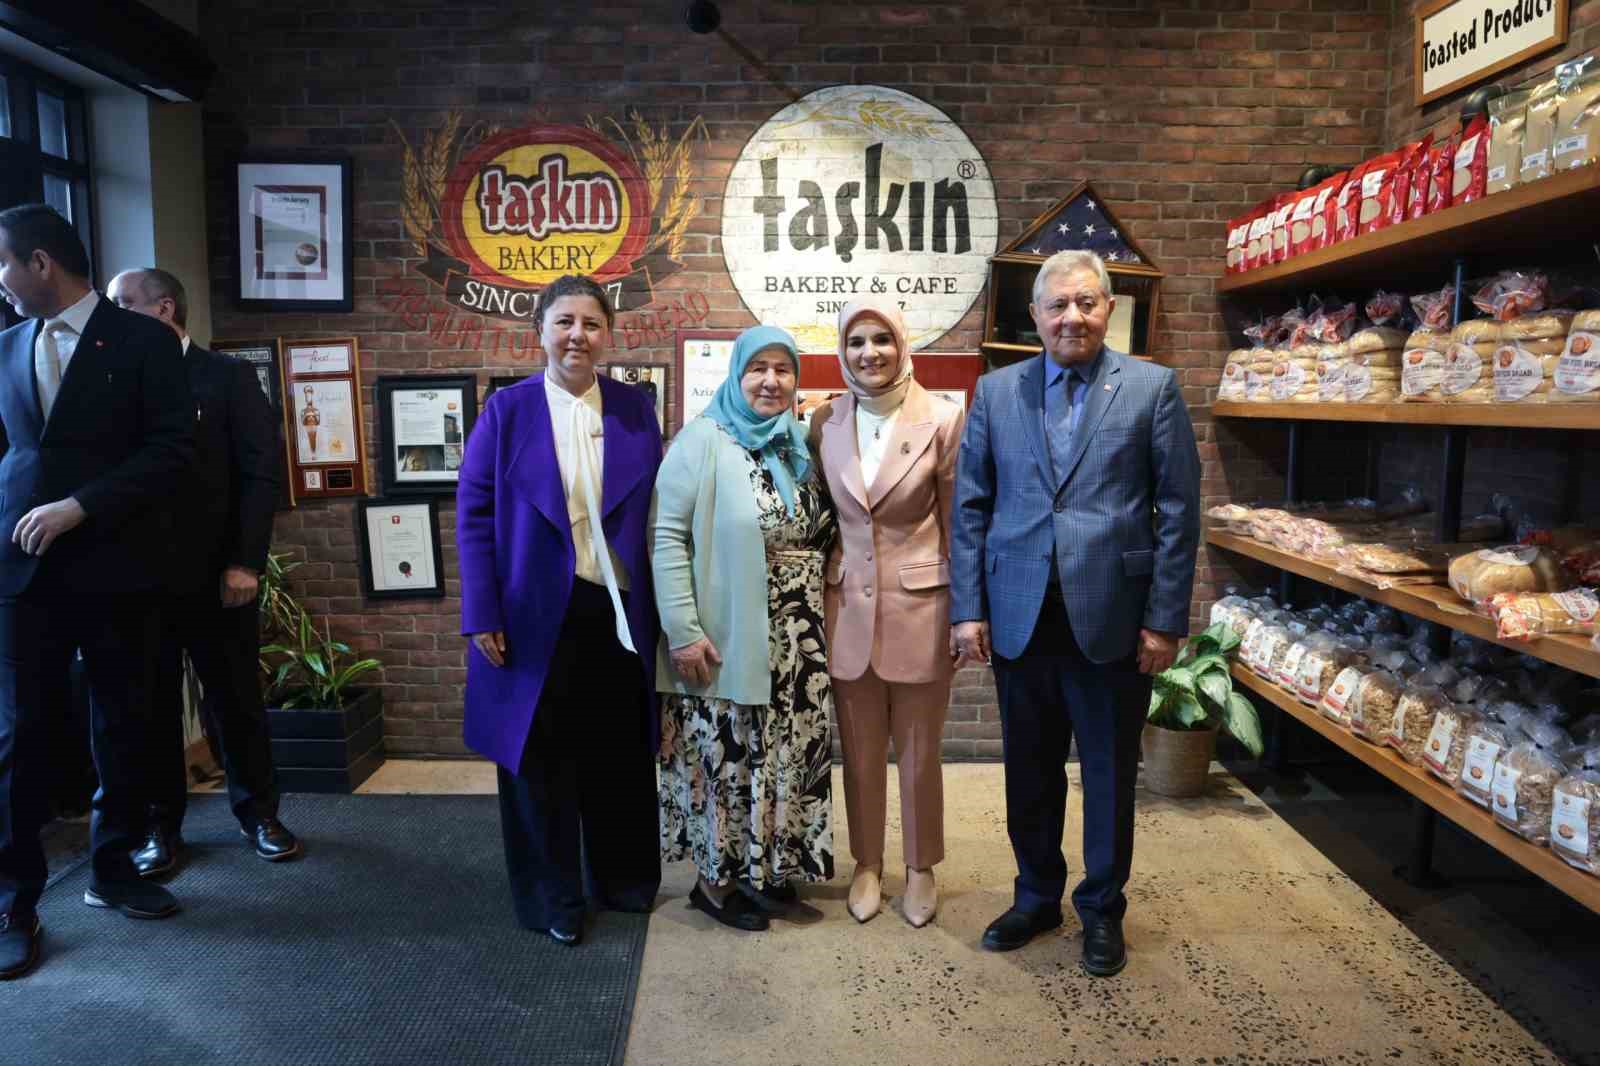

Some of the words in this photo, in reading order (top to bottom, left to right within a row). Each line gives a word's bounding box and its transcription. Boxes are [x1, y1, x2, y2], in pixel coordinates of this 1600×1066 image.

[1423, 19, 1477, 72] Toasted
[497, 245, 598, 271] BAKERY
[764, 276, 863, 293] BAKERY
[870, 277, 887, 293] &
[896, 276, 957, 294] CAFE
